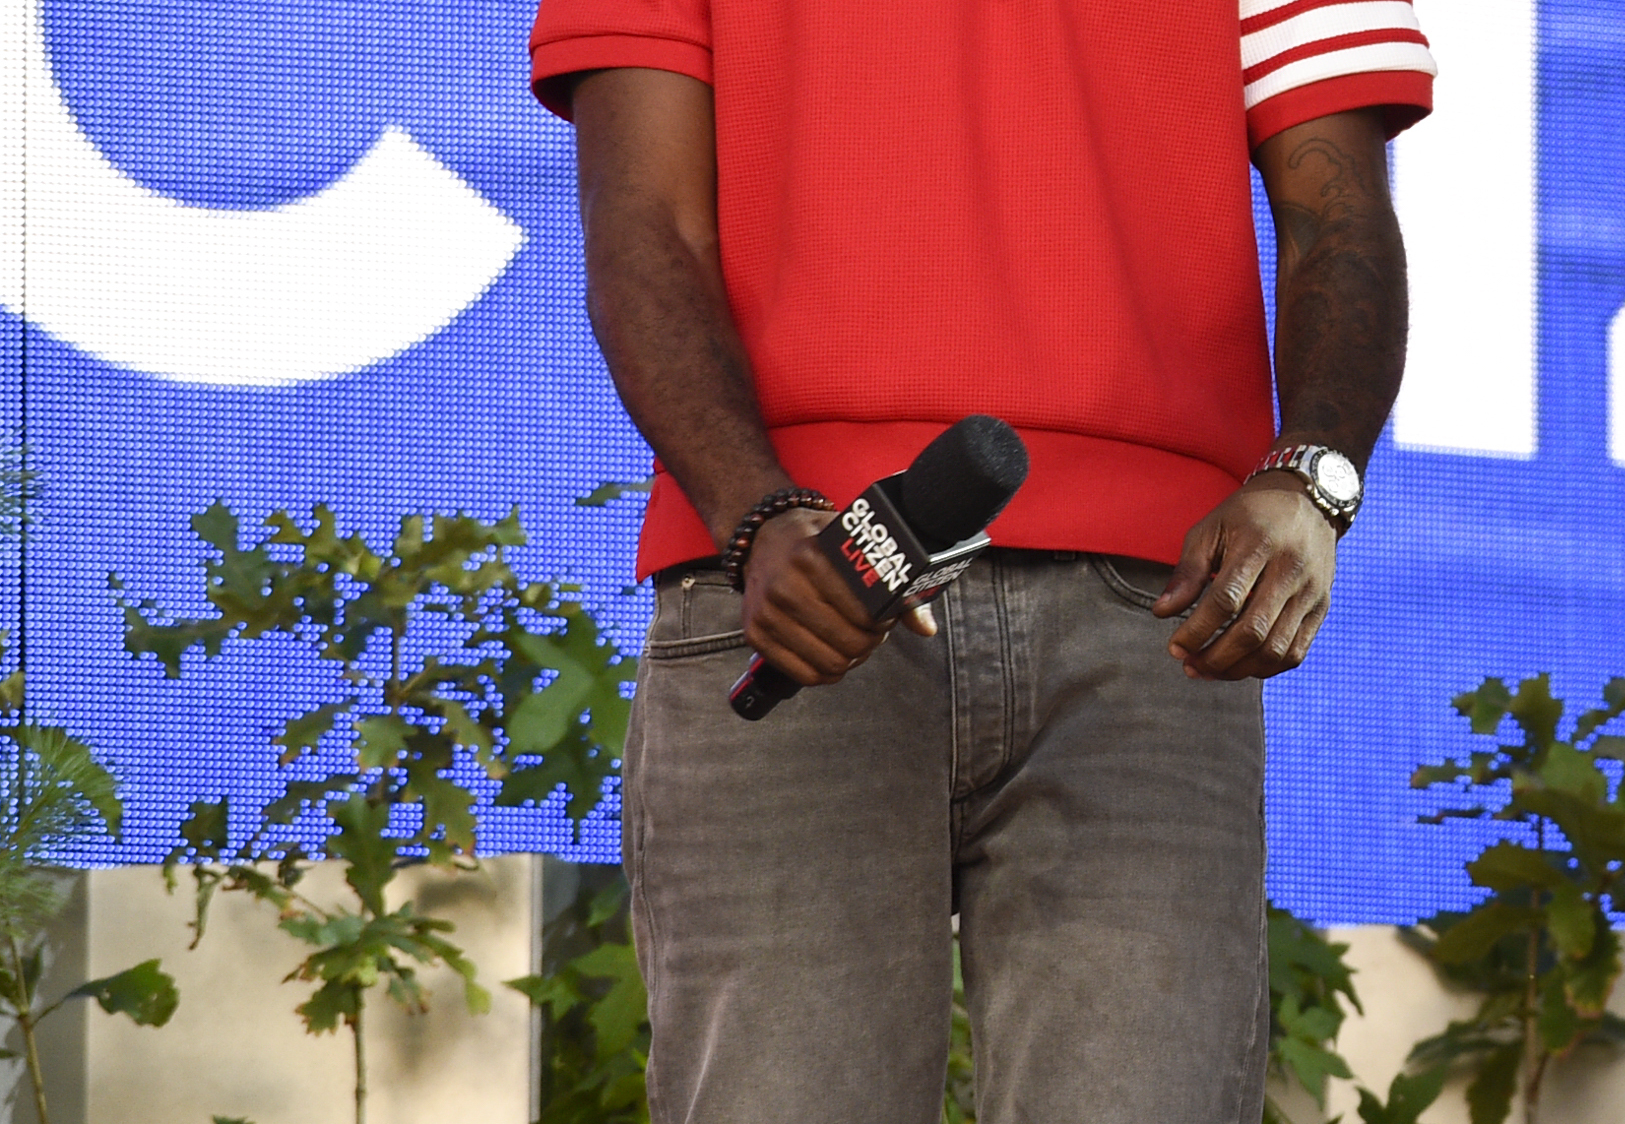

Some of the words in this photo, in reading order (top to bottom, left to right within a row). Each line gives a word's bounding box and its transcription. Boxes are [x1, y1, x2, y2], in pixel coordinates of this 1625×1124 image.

[841, 537, 881, 588] LIVE
[842, 512, 904, 592] CITIZEN
[852, 498, 913, 584] GLOBAL
